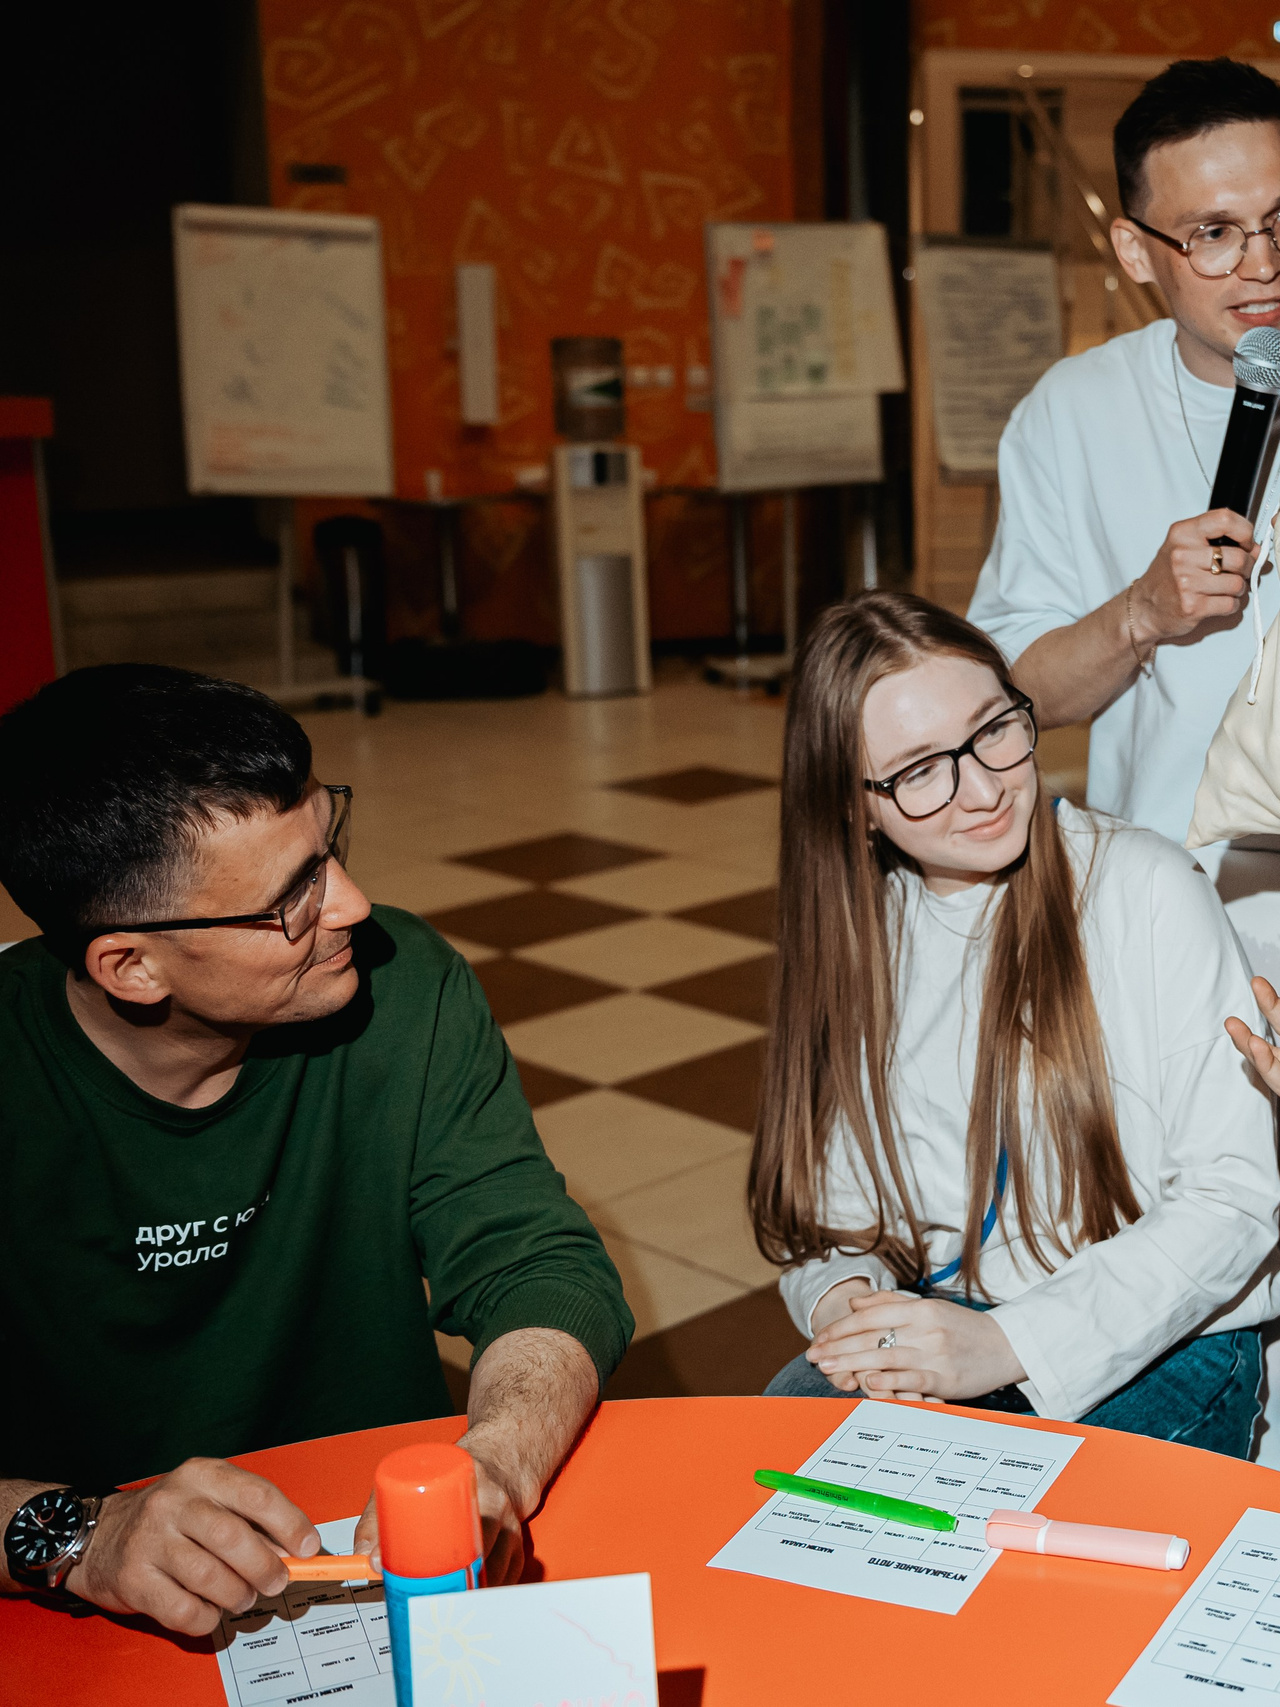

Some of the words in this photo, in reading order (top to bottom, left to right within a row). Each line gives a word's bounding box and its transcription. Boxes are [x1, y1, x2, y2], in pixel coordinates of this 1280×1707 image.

[135, 1220, 206, 1247] друг
[213, 1215, 229, 1233] с
[137, 1241, 229, 1272] урала
[866, 1556, 895, 1568] ЛОТО
[891, 1561, 968, 1582] МУЗЫКАЛЬНОЕ
